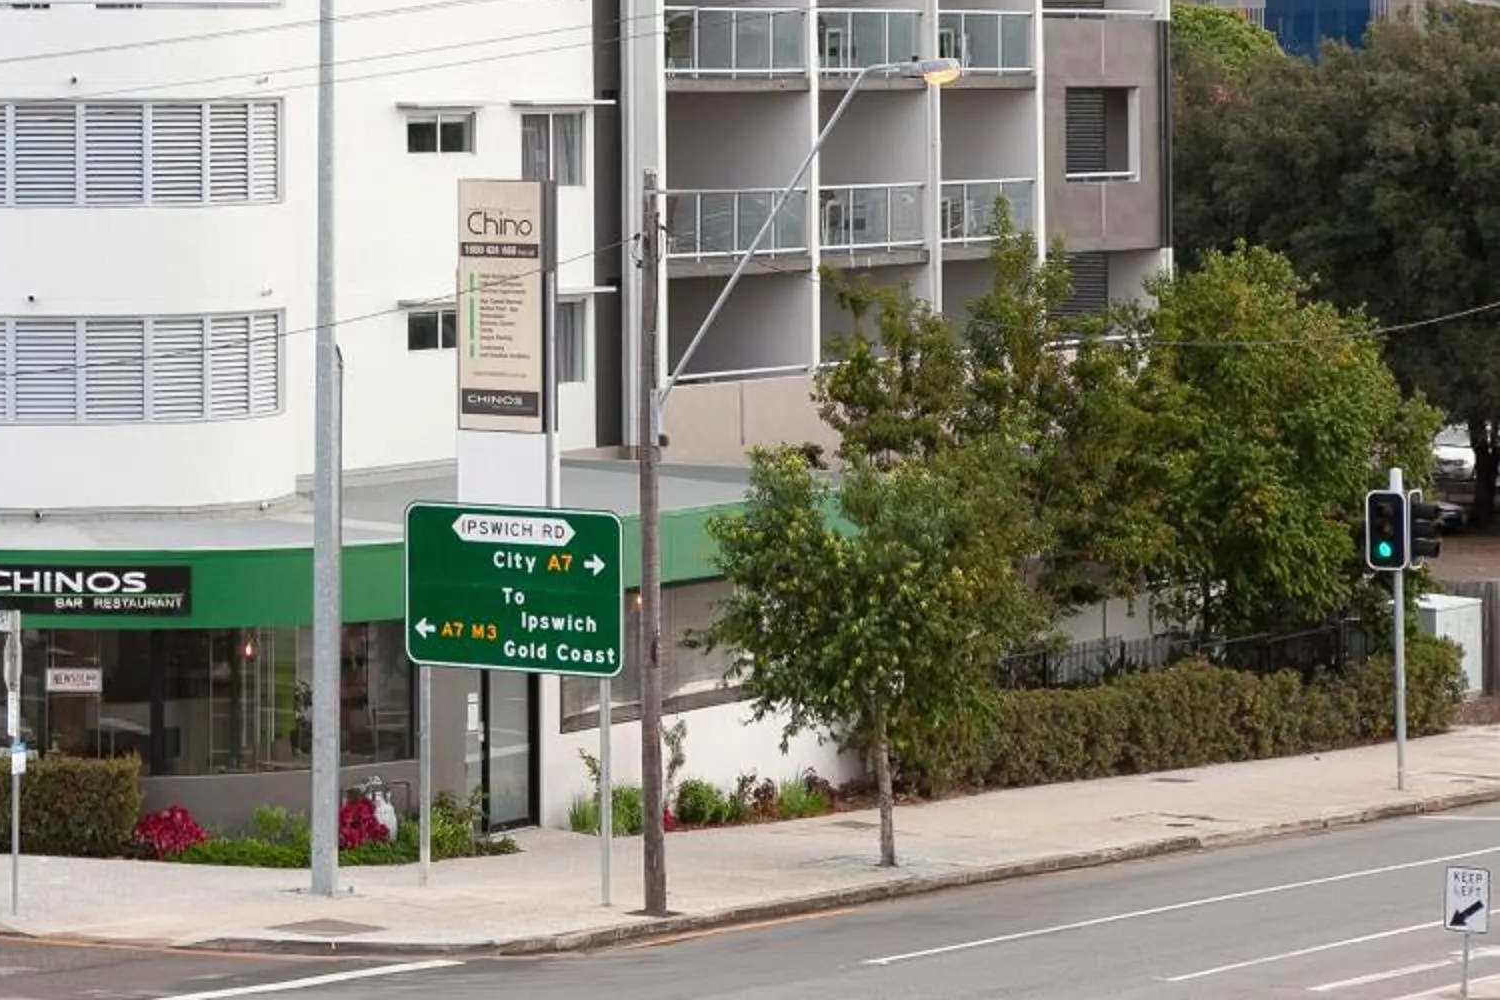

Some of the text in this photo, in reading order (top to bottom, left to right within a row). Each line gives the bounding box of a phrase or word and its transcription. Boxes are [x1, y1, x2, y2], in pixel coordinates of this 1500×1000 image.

[467, 210, 533, 237] Chino
[461, 519, 565, 540] IPSWICH RD
[493, 551, 573, 573] City A7
[54, 596, 184, 609] BAR RESTAURANT
[502, 587, 525, 605] To
[441, 621, 497, 640] A7 M3
[521, 611, 597, 633] Ipswich
[503, 640, 615, 665] Gold Coast
